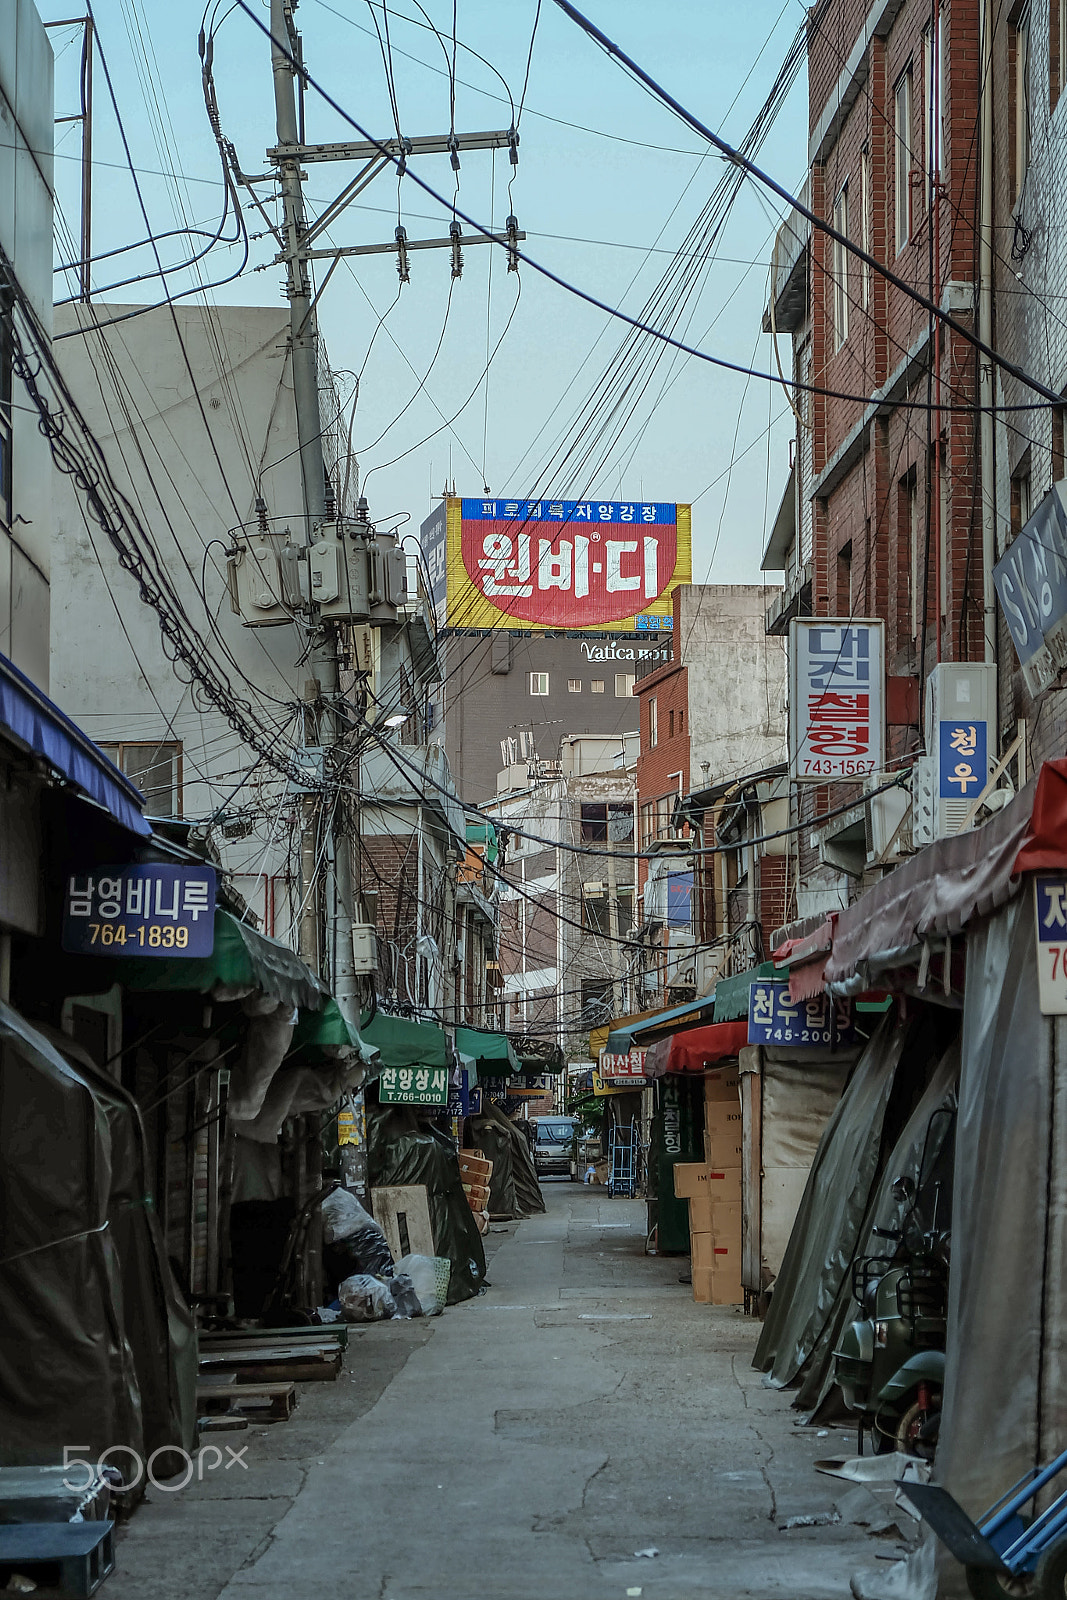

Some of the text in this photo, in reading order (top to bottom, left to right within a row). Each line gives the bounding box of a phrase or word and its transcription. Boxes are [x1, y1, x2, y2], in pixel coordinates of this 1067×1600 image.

[580, 641, 636, 663] Vatica
[803, 760, 876, 776] 743-1567
[947, 726, 978, 794] 천우
[69, 876, 209, 921] 남영비니루
[88, 923, 189, 948] 764-1839
[602, 1052, 648, 1075] 아산철
